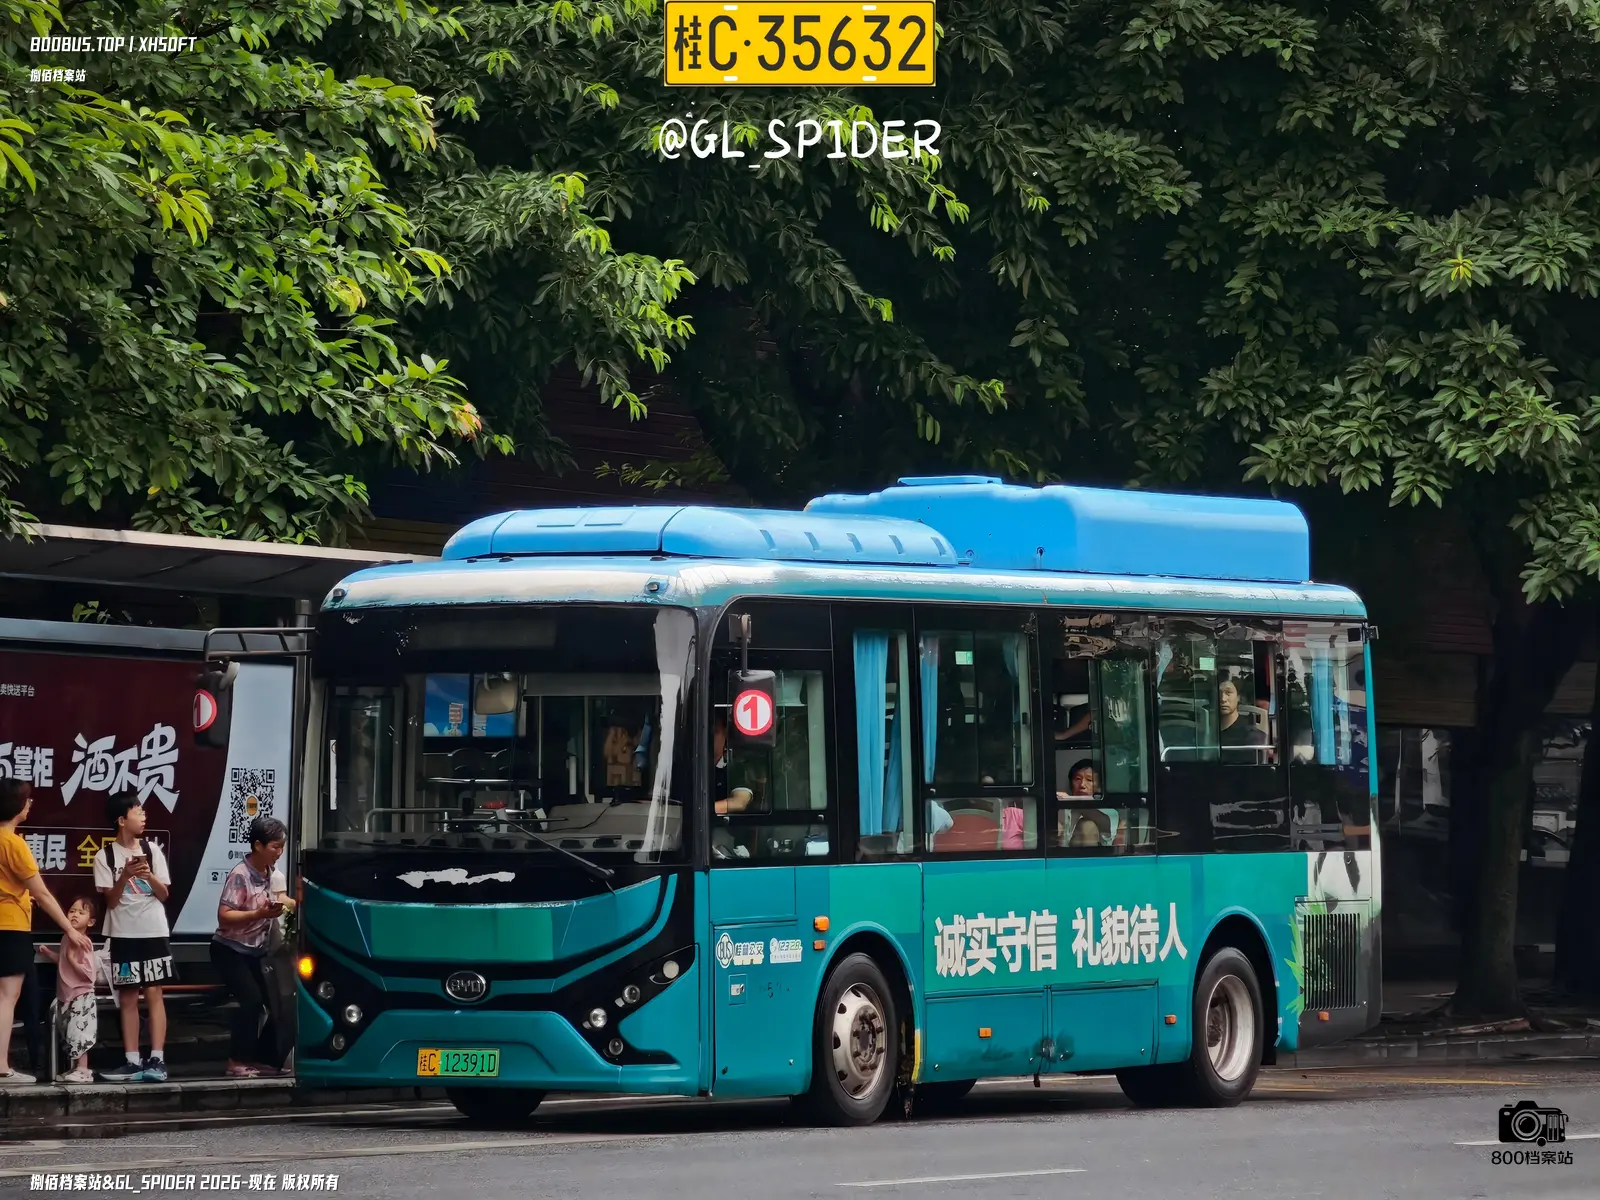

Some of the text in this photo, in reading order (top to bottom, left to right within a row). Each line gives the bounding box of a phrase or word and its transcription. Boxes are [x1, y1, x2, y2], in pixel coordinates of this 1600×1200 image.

[742, 696, 759, 729] 1
[60, 722, 181, 815] 酒不贵
[19, 833, 67, 871] 惠民
[934, 901, 1188, 978] 诚实守信 礼貌待人
[451, 979, 482, 993] BYD
